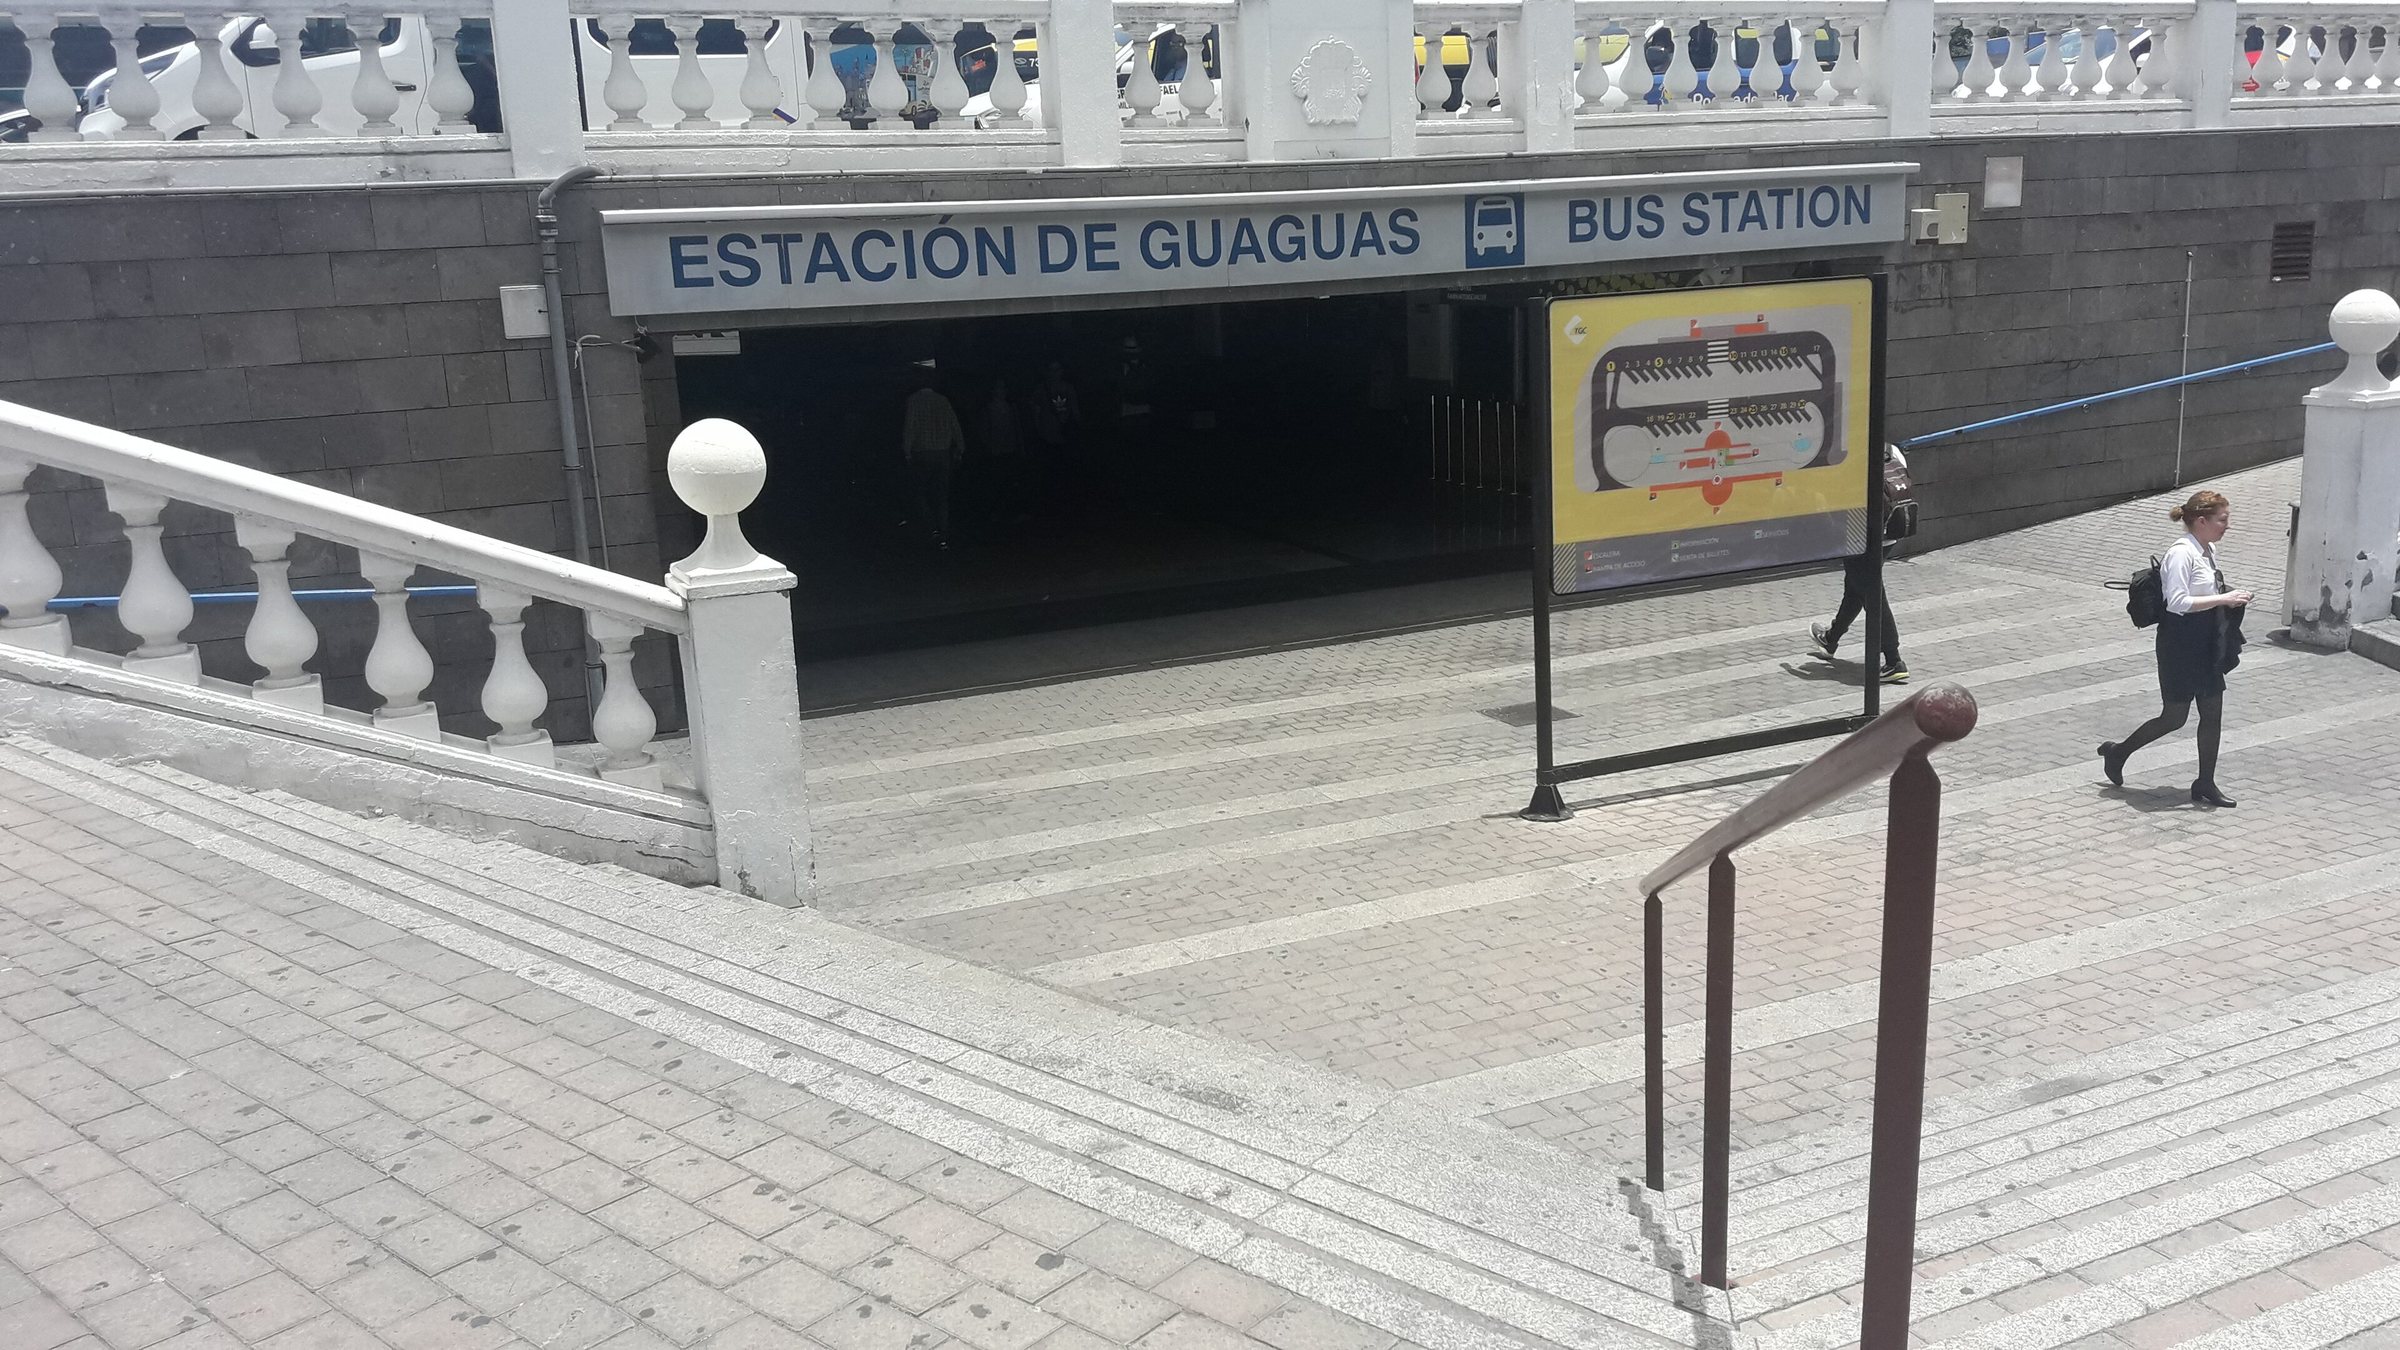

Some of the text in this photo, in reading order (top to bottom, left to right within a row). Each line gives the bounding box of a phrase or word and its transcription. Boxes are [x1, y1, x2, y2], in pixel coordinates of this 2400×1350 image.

[669, 207, 1421, 288] ESTACIÓN DE GUAGUAS
[1568, 184, 1871, 243] BUS STATION
